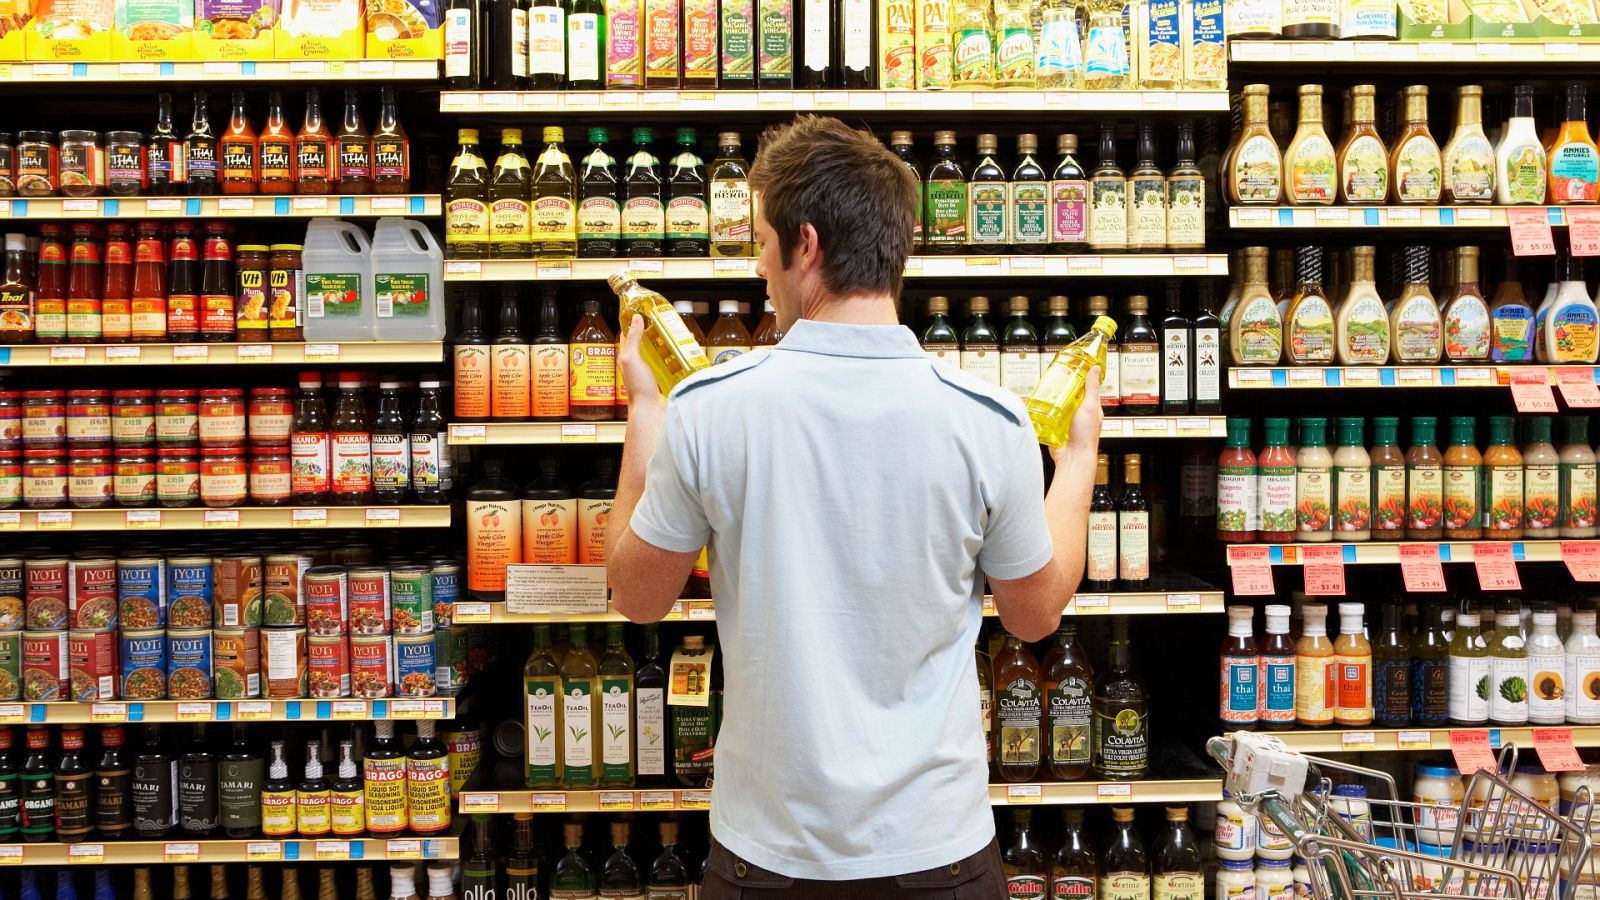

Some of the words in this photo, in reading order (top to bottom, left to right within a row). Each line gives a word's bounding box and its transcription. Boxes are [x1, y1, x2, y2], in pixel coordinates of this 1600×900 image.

[191, 148, 214, 158] THAI
[376, 152, 402, 164] THAI
[112, 154, 140, 166] THAI
[224, 153, 252, 165] THAI
[262, 153, 288, 165] THAI
[298, 153, 326, 165] THAI
[340, 153, 368, 165] THAI
[451, 202, 480, 210] BORGES
[495, 202, 524, 210] BORGES
[673, 199, 700, 208] BORGES
[2, 292, 23, 302] Thai
[1236, 685, 1253, 693] thai
[1273, 684, 1290, 692] thai
[1000, 698, 1040, 707] COLAVITA
[1051, 697, 1091, 706] COLAVITA
[1108, 736, 1144, 744] COLAVITA
[366, 770, 403, 781] BRAGG
[408, 770, 443, 781] BRAGG
[1008, 883, 1042, 894] Gallo
[1056, 884, 1091, 894] Gallo
